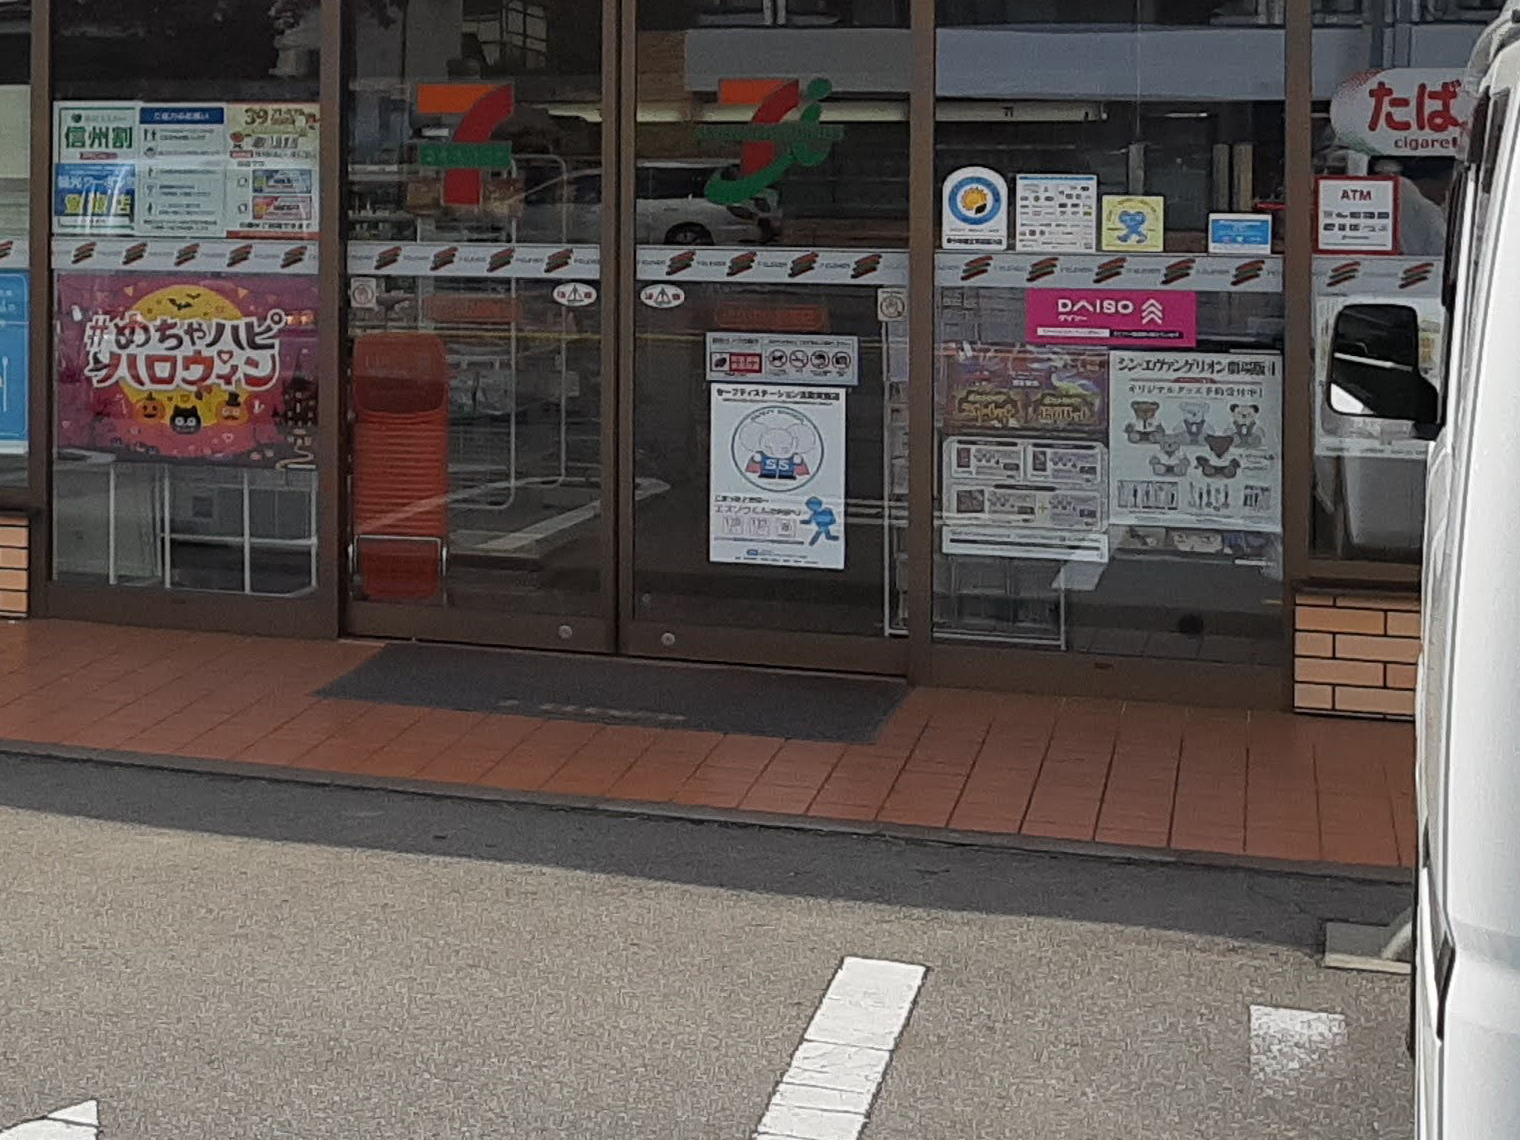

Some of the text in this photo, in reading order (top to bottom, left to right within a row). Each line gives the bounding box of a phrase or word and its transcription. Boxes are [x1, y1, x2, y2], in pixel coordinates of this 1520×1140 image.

[1368, 79, 1469, 133] たば
[65, 126, 132, 149] 信州割
[1340, 189, 1372, 201] ATM
[1057, 299, 1134, 314] DAISO
[93, 349, 277, 388] ハロウィン
